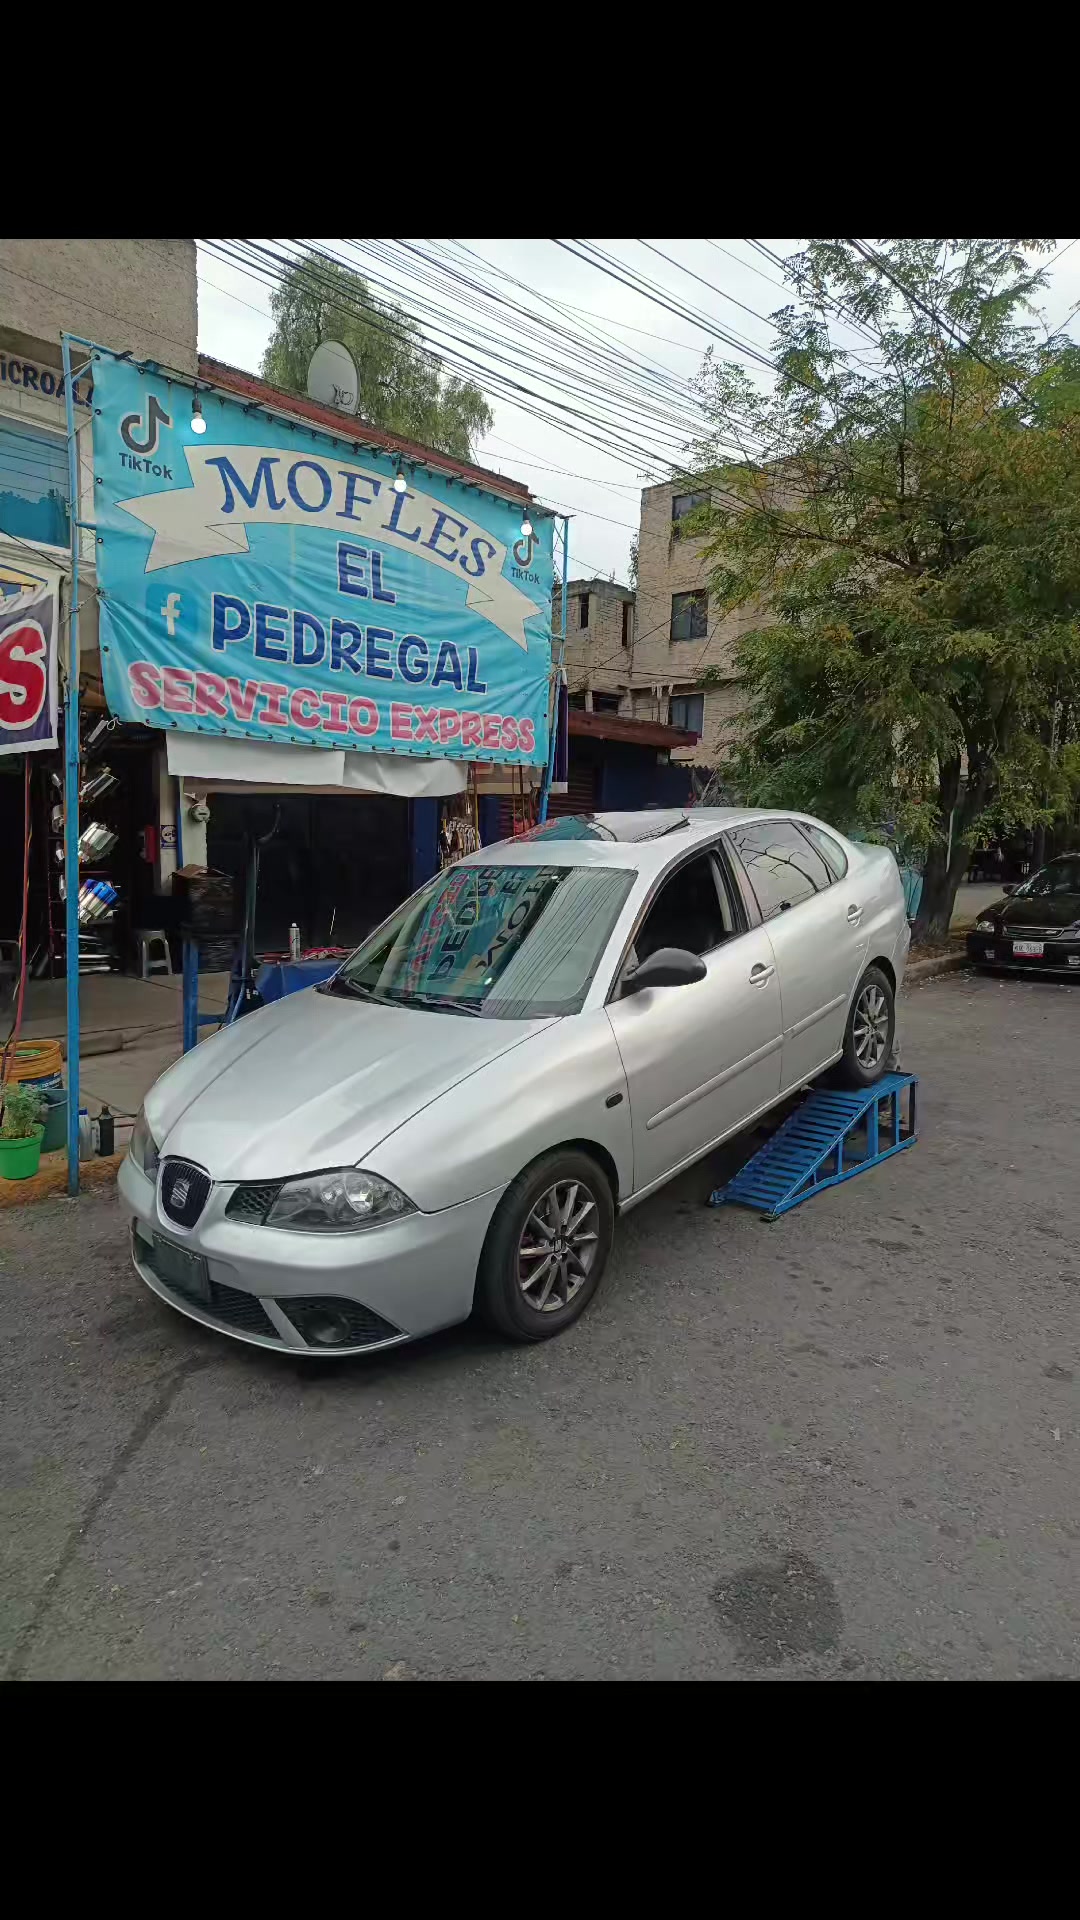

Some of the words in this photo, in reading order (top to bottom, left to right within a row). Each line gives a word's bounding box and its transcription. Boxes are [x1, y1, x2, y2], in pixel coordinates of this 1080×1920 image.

[118, 452, 173, 481] TikTok
[204, 455, 497, 577] MOFLES
[337, 540, 397, 606] EL
[511, 567, 540, 585] TikTok
[210, 591, 488, 696] PEDREGAL
[127, 660, 380, 737] SERVICIO
[390, 700, 536, 753] EXPRESS
